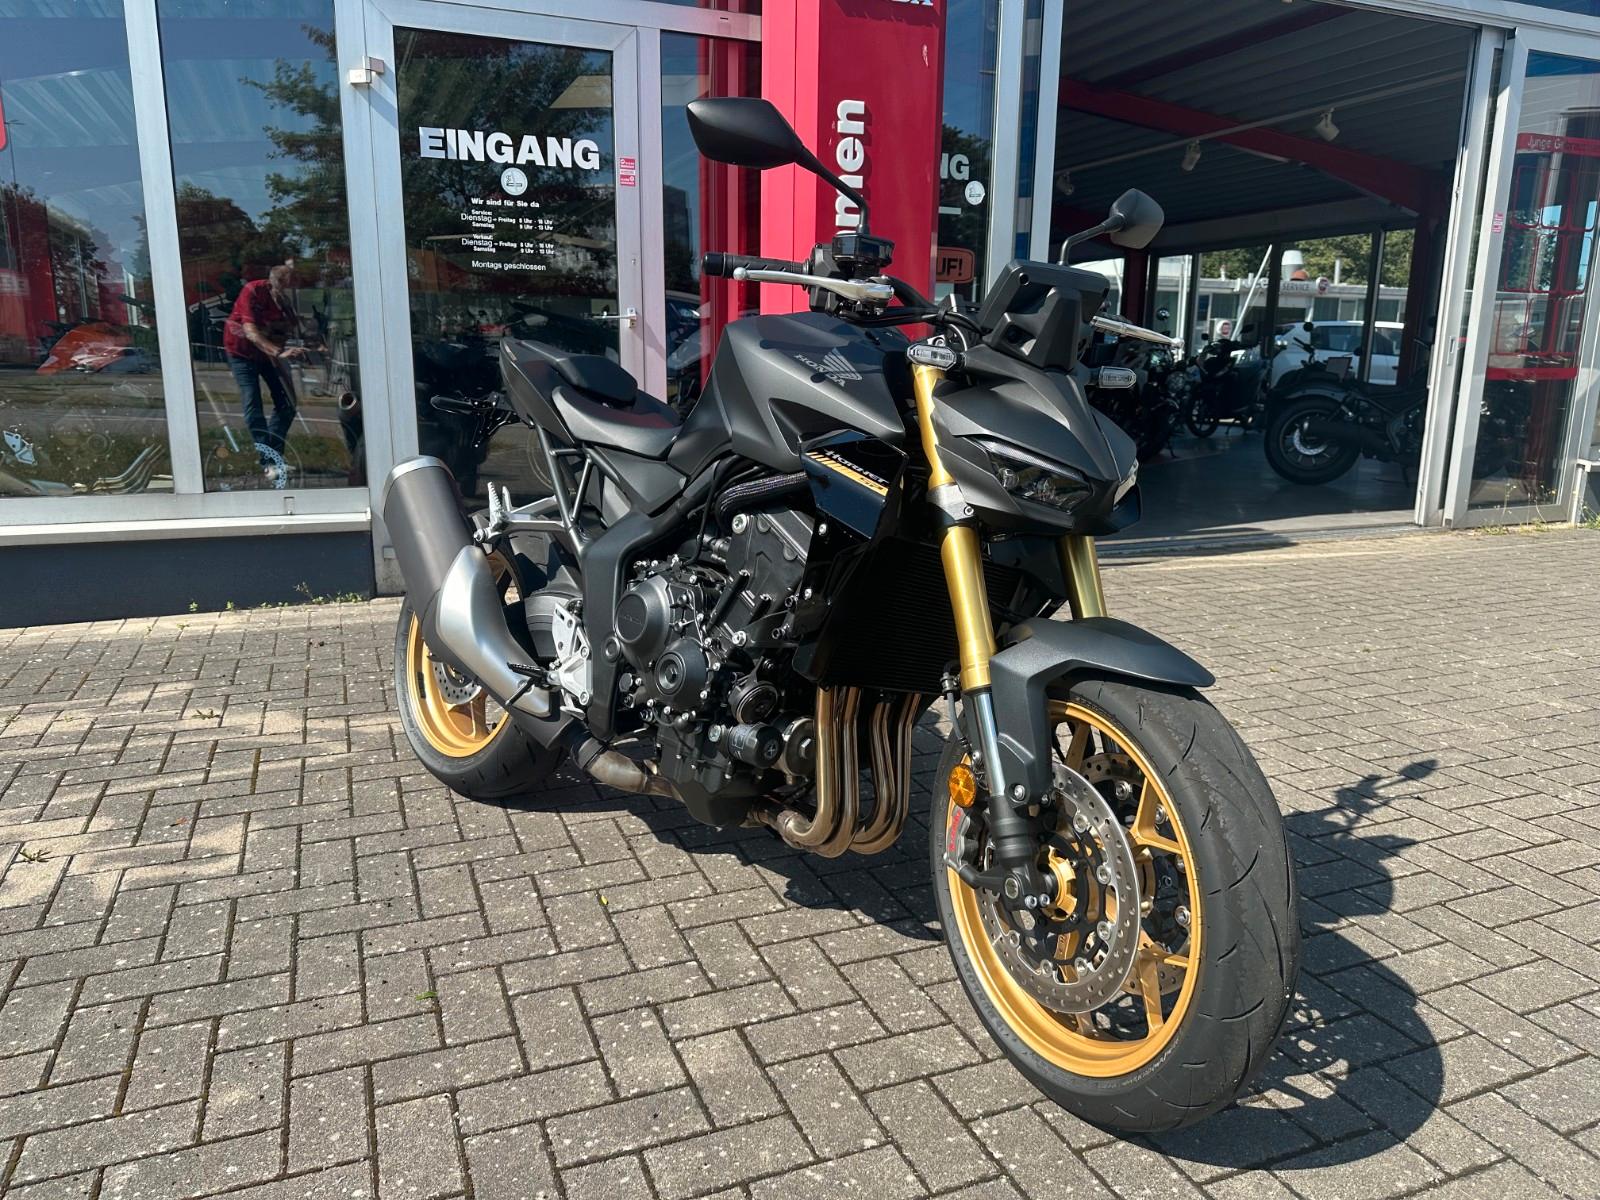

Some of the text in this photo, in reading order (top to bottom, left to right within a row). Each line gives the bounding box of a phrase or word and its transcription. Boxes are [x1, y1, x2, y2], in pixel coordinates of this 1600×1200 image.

[418, 126, 600, 170] EINGANG
[835, 99, 865, 236] men
[486, 198, 502, 206] sind
[460, 213, 492, 223] Dienstag
[472, 221, 495, 229] Samstag
[461, 238, 493, 247] Dienstag
[471, 260, 547, 271] Montags geschlossen
[794, 354, 846, 387] HONDA
